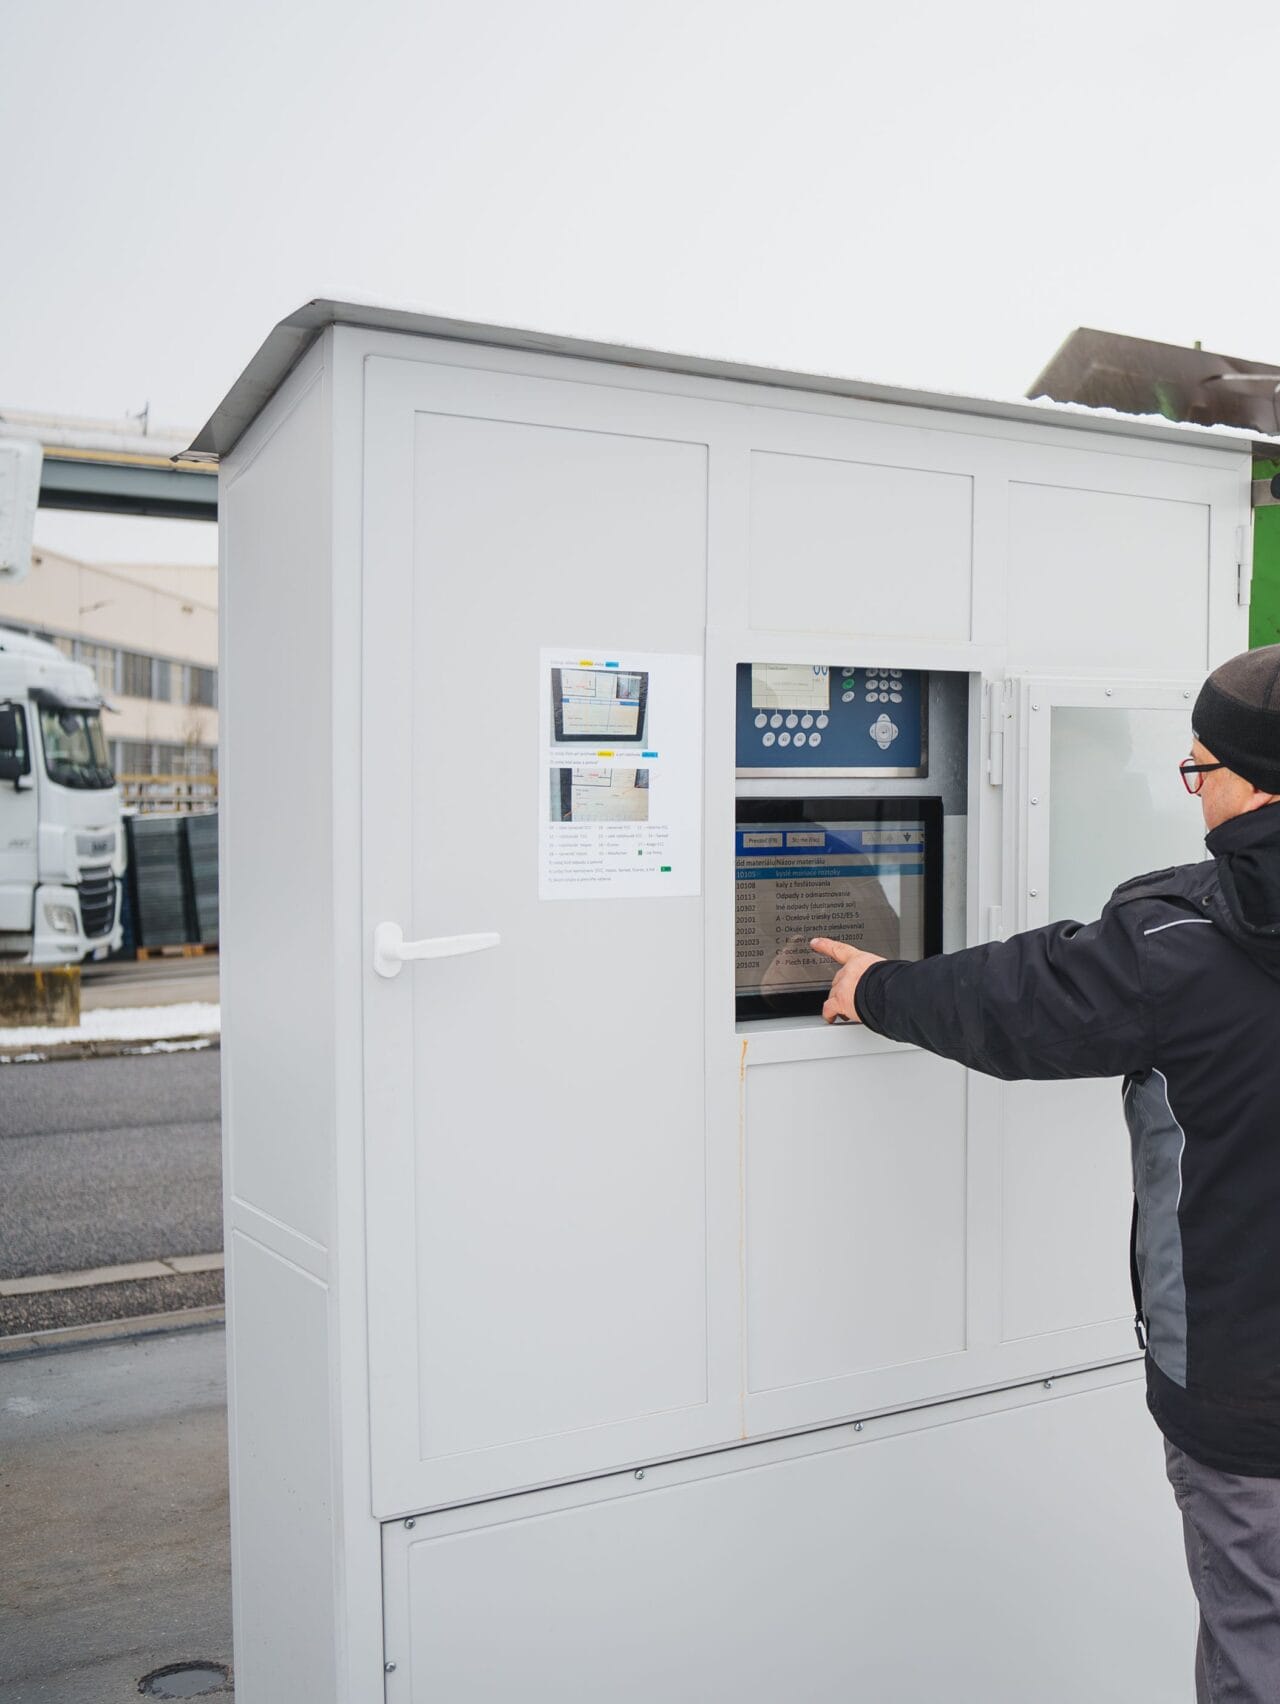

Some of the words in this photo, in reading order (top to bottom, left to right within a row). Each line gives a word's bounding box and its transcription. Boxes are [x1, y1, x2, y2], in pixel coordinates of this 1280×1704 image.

[736, 893, 756, 901] 10113
[775, 892, 800, 901] Odpady
[736, 916, 756, 924] 20101
[736, 927, 756, 935] 20102
